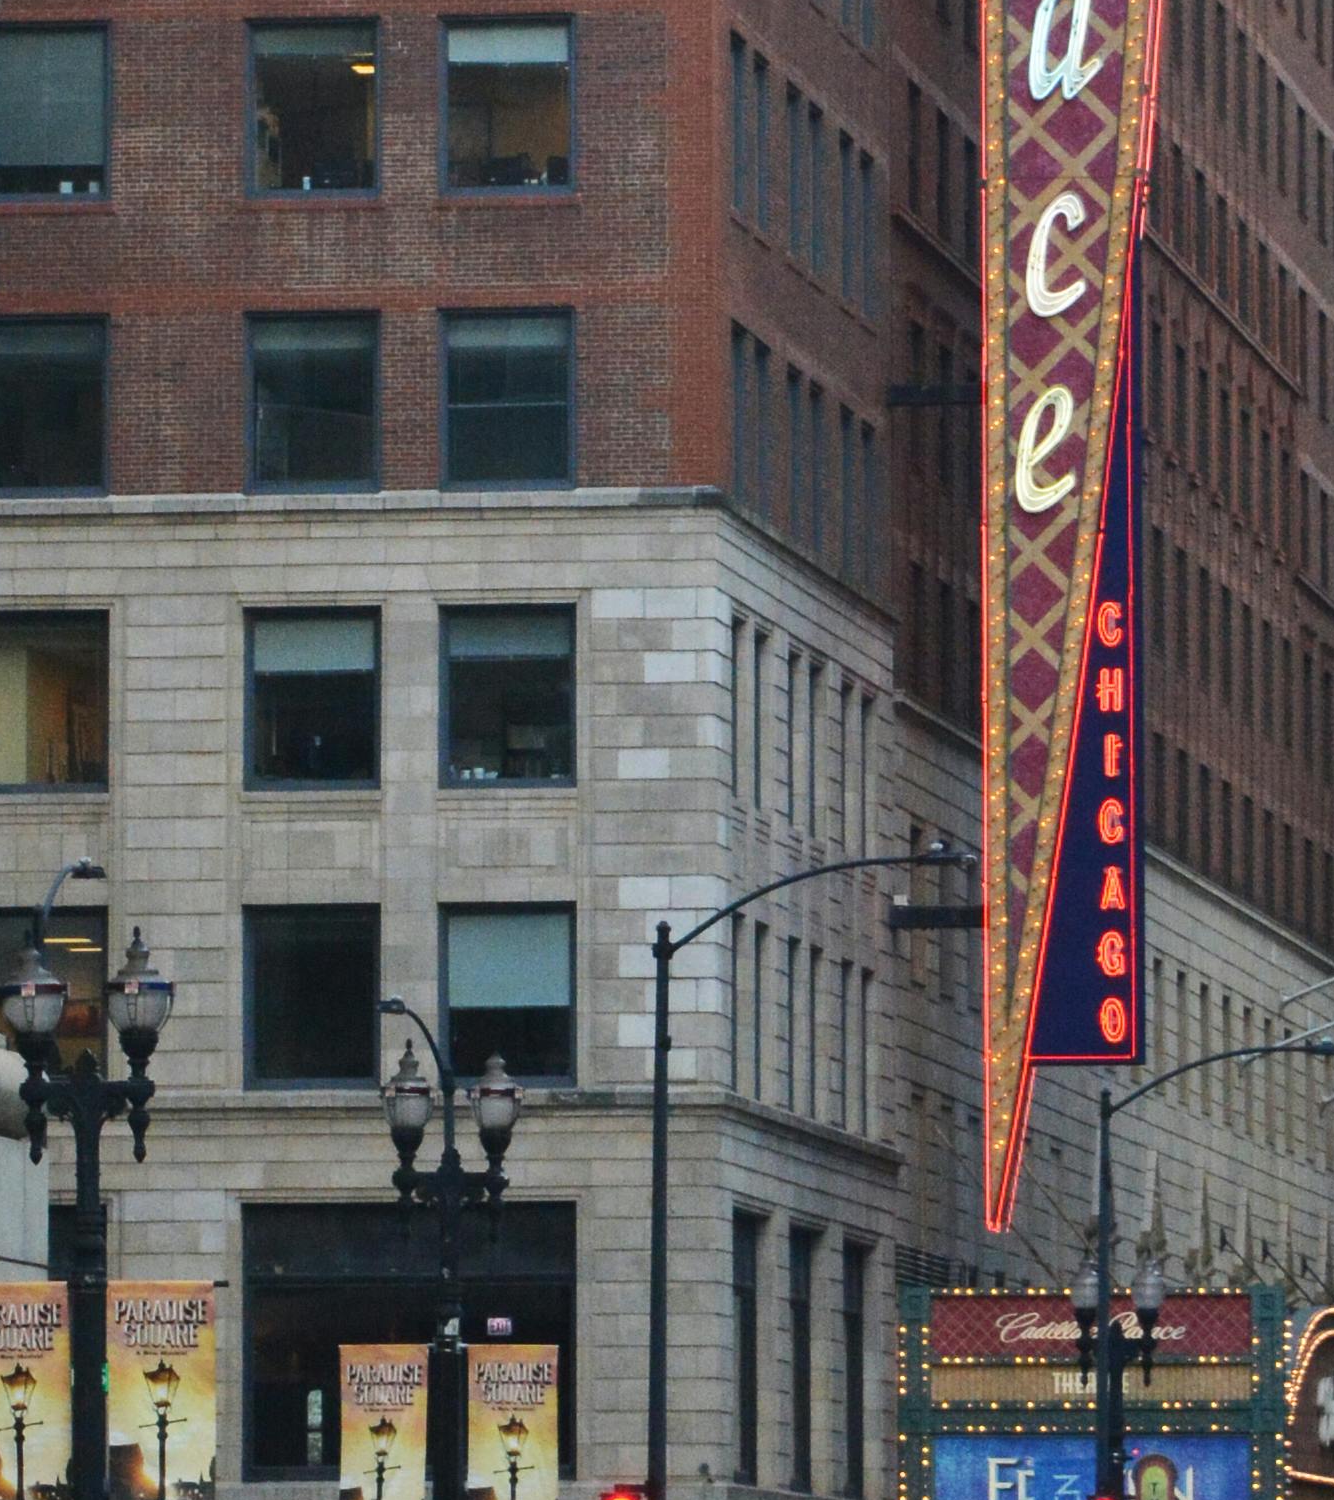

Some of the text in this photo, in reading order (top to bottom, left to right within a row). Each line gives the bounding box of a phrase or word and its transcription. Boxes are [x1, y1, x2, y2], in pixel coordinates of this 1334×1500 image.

[1096, 601, 1126, 1043] CHICAGO
[115, 1300, 207, 1324] PARADISE
[123, 1323, 199, 1348] SQUARE
[346, 1364, 423, 1385] PARADISE
[475, 1363, 551, 1384] PARADISE
[354, 1384, 414, 1405] SQUARE
[482, 1384, 545, 1405] SQUARE
